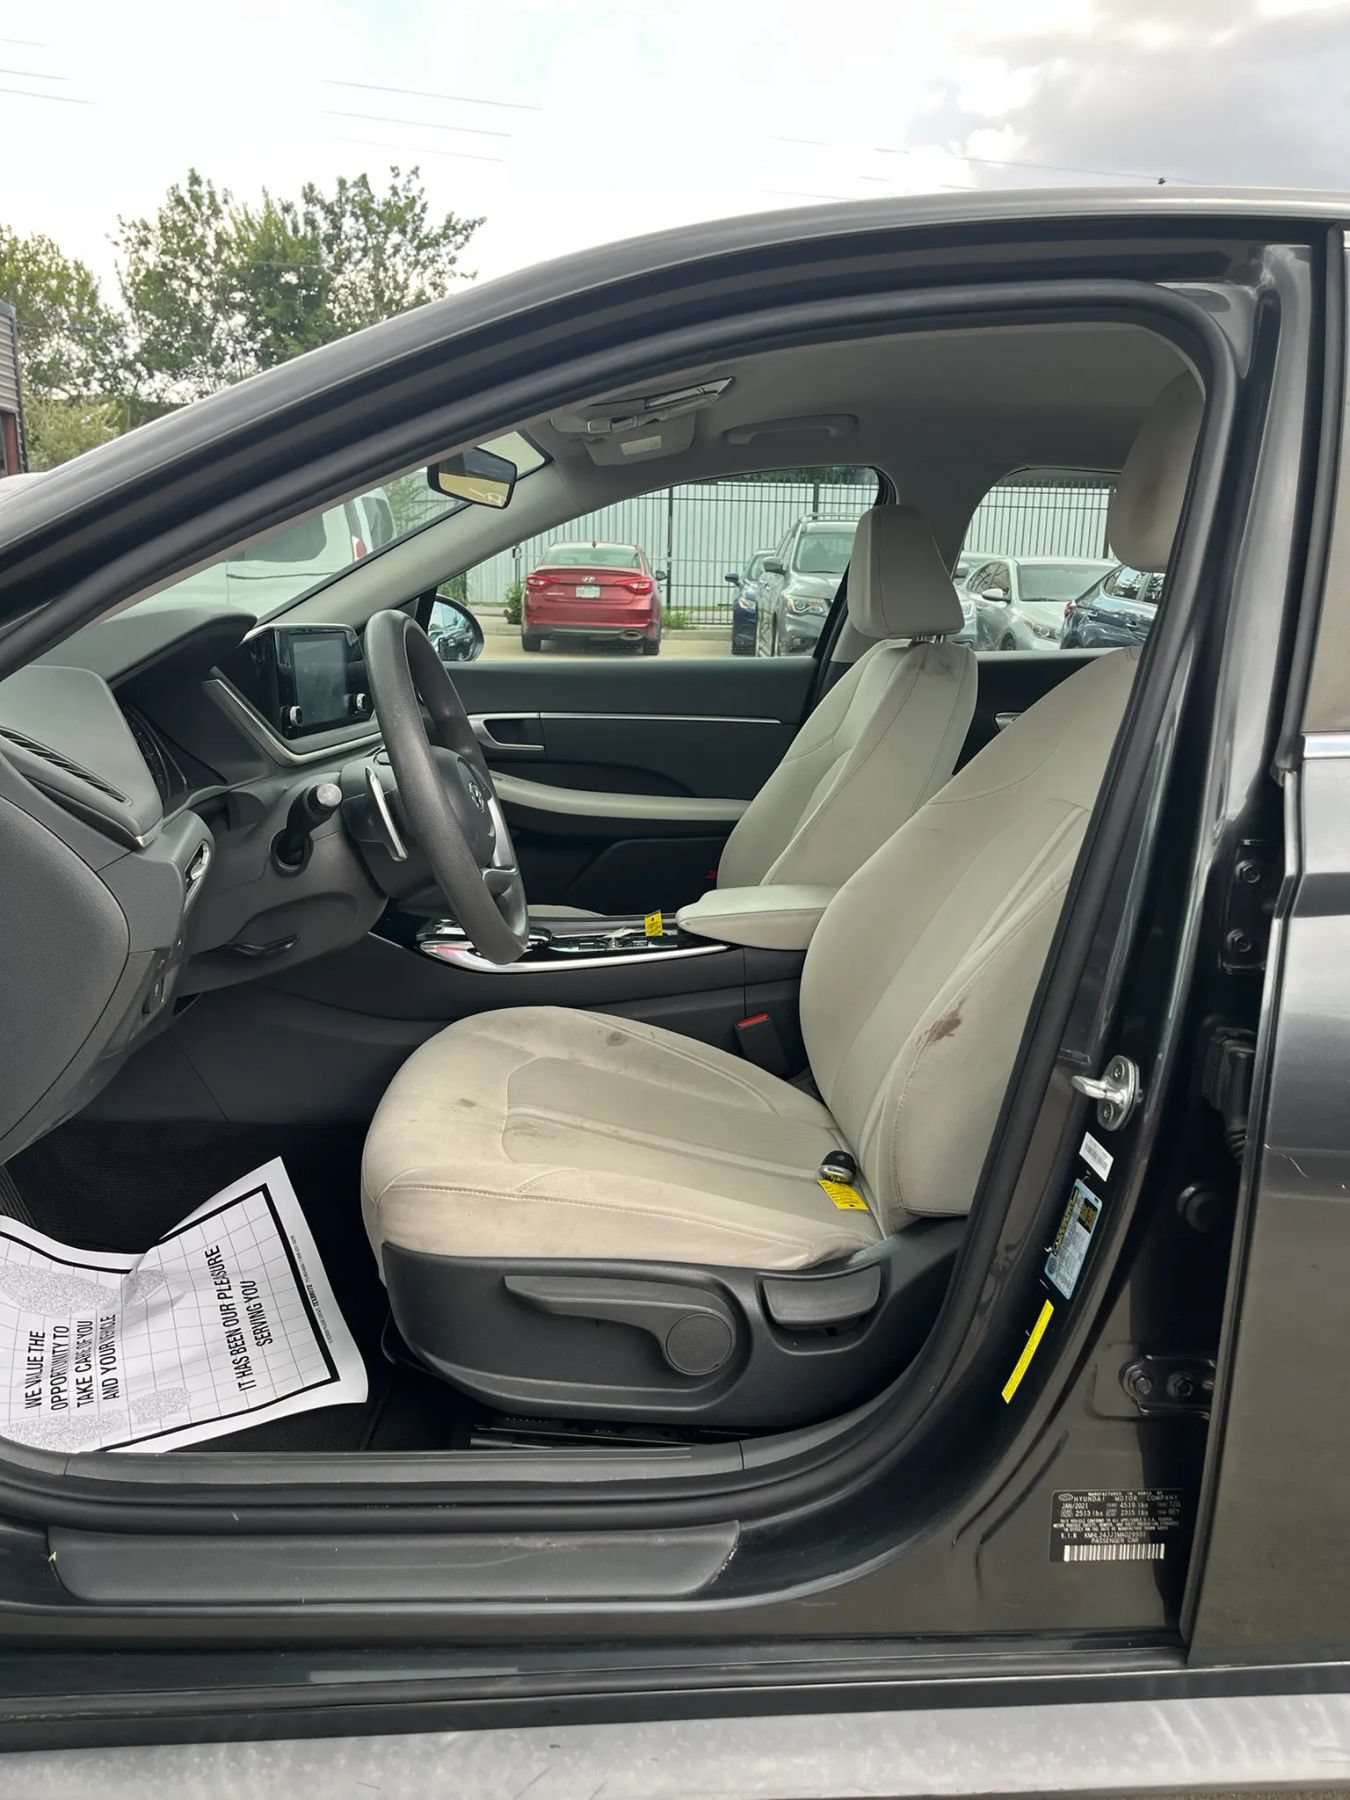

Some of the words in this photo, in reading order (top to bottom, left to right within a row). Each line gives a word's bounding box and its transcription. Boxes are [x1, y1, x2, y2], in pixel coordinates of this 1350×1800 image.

[205, 1245, 234, 1300] PLEASURE
[240, 1280, 260, 1303] YOU
[220, 1303, 240, 1328] OUR
[246, 1302, 273, 1347] SERVING
[53, 1326, 69, 1339] TO
[77, 1321, 93, 1339] YOU
[100, 1314, 115, 1344] VEHICLE
[28, 1331, 45, 1353] THE
[225, 1328, 247, 1356] BEEN
[75, 1348, 91, 1373] CARE
[99, 1341, 116, 1375] YOUR
[232, 1356, 253, 1378] HAS
[25, 1356, 43, 1389] VALUE
[50, 1342, 68, 1410] OPPORTUNITY
[76, 1376, 94, 1408] TAKE
[102, 1378, 119, 1400] AND
[238, 1380, 256, 1391] IT
[25, 1388, 42, 1409] WE
